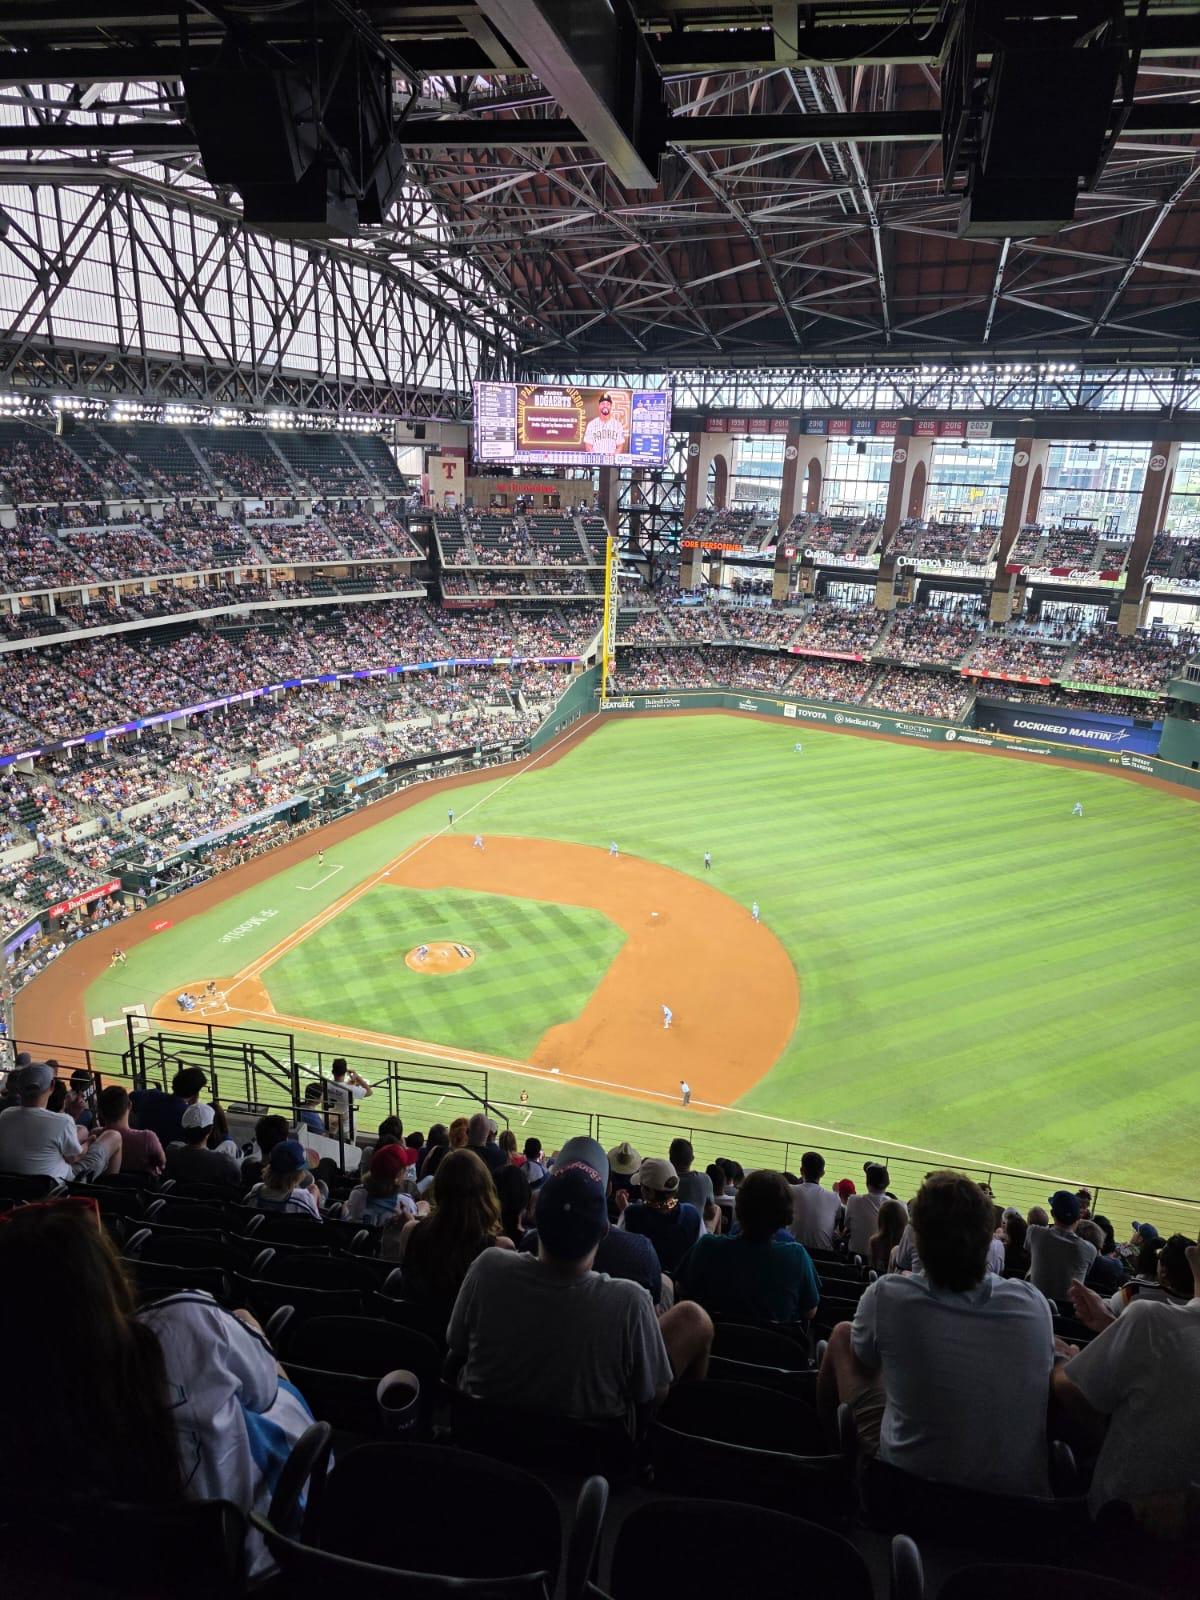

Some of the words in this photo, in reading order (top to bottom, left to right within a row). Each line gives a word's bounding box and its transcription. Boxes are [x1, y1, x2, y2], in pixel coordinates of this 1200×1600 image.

[534, 395, 572, 408] BOGAERTS
[832, 420, 847, 428] 2011
[856, 420, 871, 428] 2011
[969, 421, 989, 430] 2023
[786, 448, 796, 457] 34
[894, 451, 905, 460] 26
[1018, 455, 1025, 464] 7
[1152, 458, 1165, 468] 29
[442, 463, 456, 479] T
[681, 540, 699, 549] CORE
[700, 541, 743, 552] PERSONNEL
[897, 556, 942, 568] Comerica
[944, 559, 970, 568] Bank
[1070, 681, 1105, 693] LUXOR
[1107, 686, 1156, 699] STAFFING
[600, 701, 635, 710] SEATGEEK
[798, 709, 827, 720] TOYOTA
[844, 716, 868, 727] Medical
[868, 719, 882, 730] City
[898, 723, 932, 734] CHOCTAW
[1013, 719, 1067, 735] LOCKHEED
[1068, 728, 1112, 741] MARTIN
[1131, 757, 1151, 767] ENERGY
[68, 888, 106, 910] Budweiser
